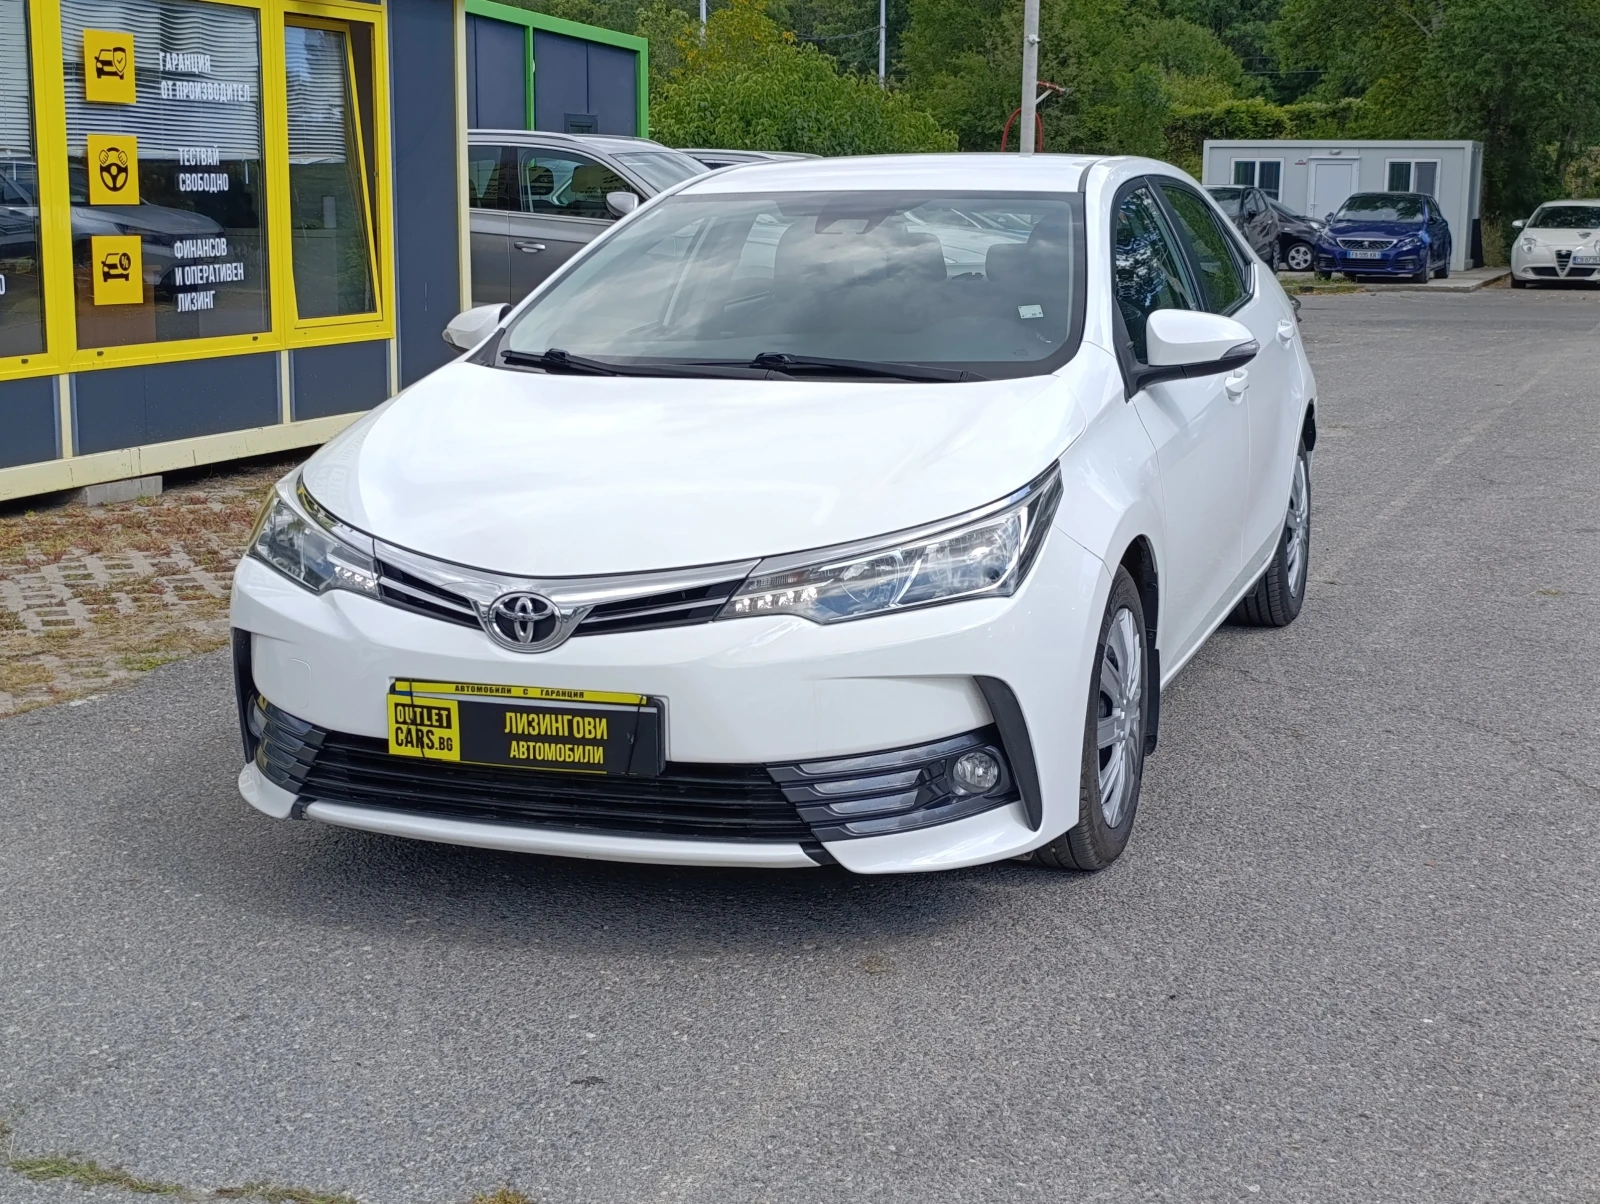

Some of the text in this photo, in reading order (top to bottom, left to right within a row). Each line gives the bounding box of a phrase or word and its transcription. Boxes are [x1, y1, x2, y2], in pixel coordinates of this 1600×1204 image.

[159, 52, 211, 74] ГАРАНЦИЯ
[161, 81, 250, 102] ОТ ПРОИЗВОДИТЕЛ
[178, 145, 220, 166] ТЕСТВАЙ
[179, 173, 229, 193] СВОБОДНО
[174, 238, 228, 259] ФИНАНСОВ
[175, 262, 244, 286] И ОПЕРАТИВЕН
[177, 290, 215, 312] ЛИЗИНГ
[455, 685, 512, 694] АВТОМОБИЛИ
[540, 689, 584, 698] ГАРАНЦИЯ
[396, 705, 448, 727] OUTLET
[504, 711, 608, 740] ЛИЗИНГОВИ
[395, 726, 453, 752] CARS.BG
[510, 740, 604, 764] АВТОМОБИЛИ
